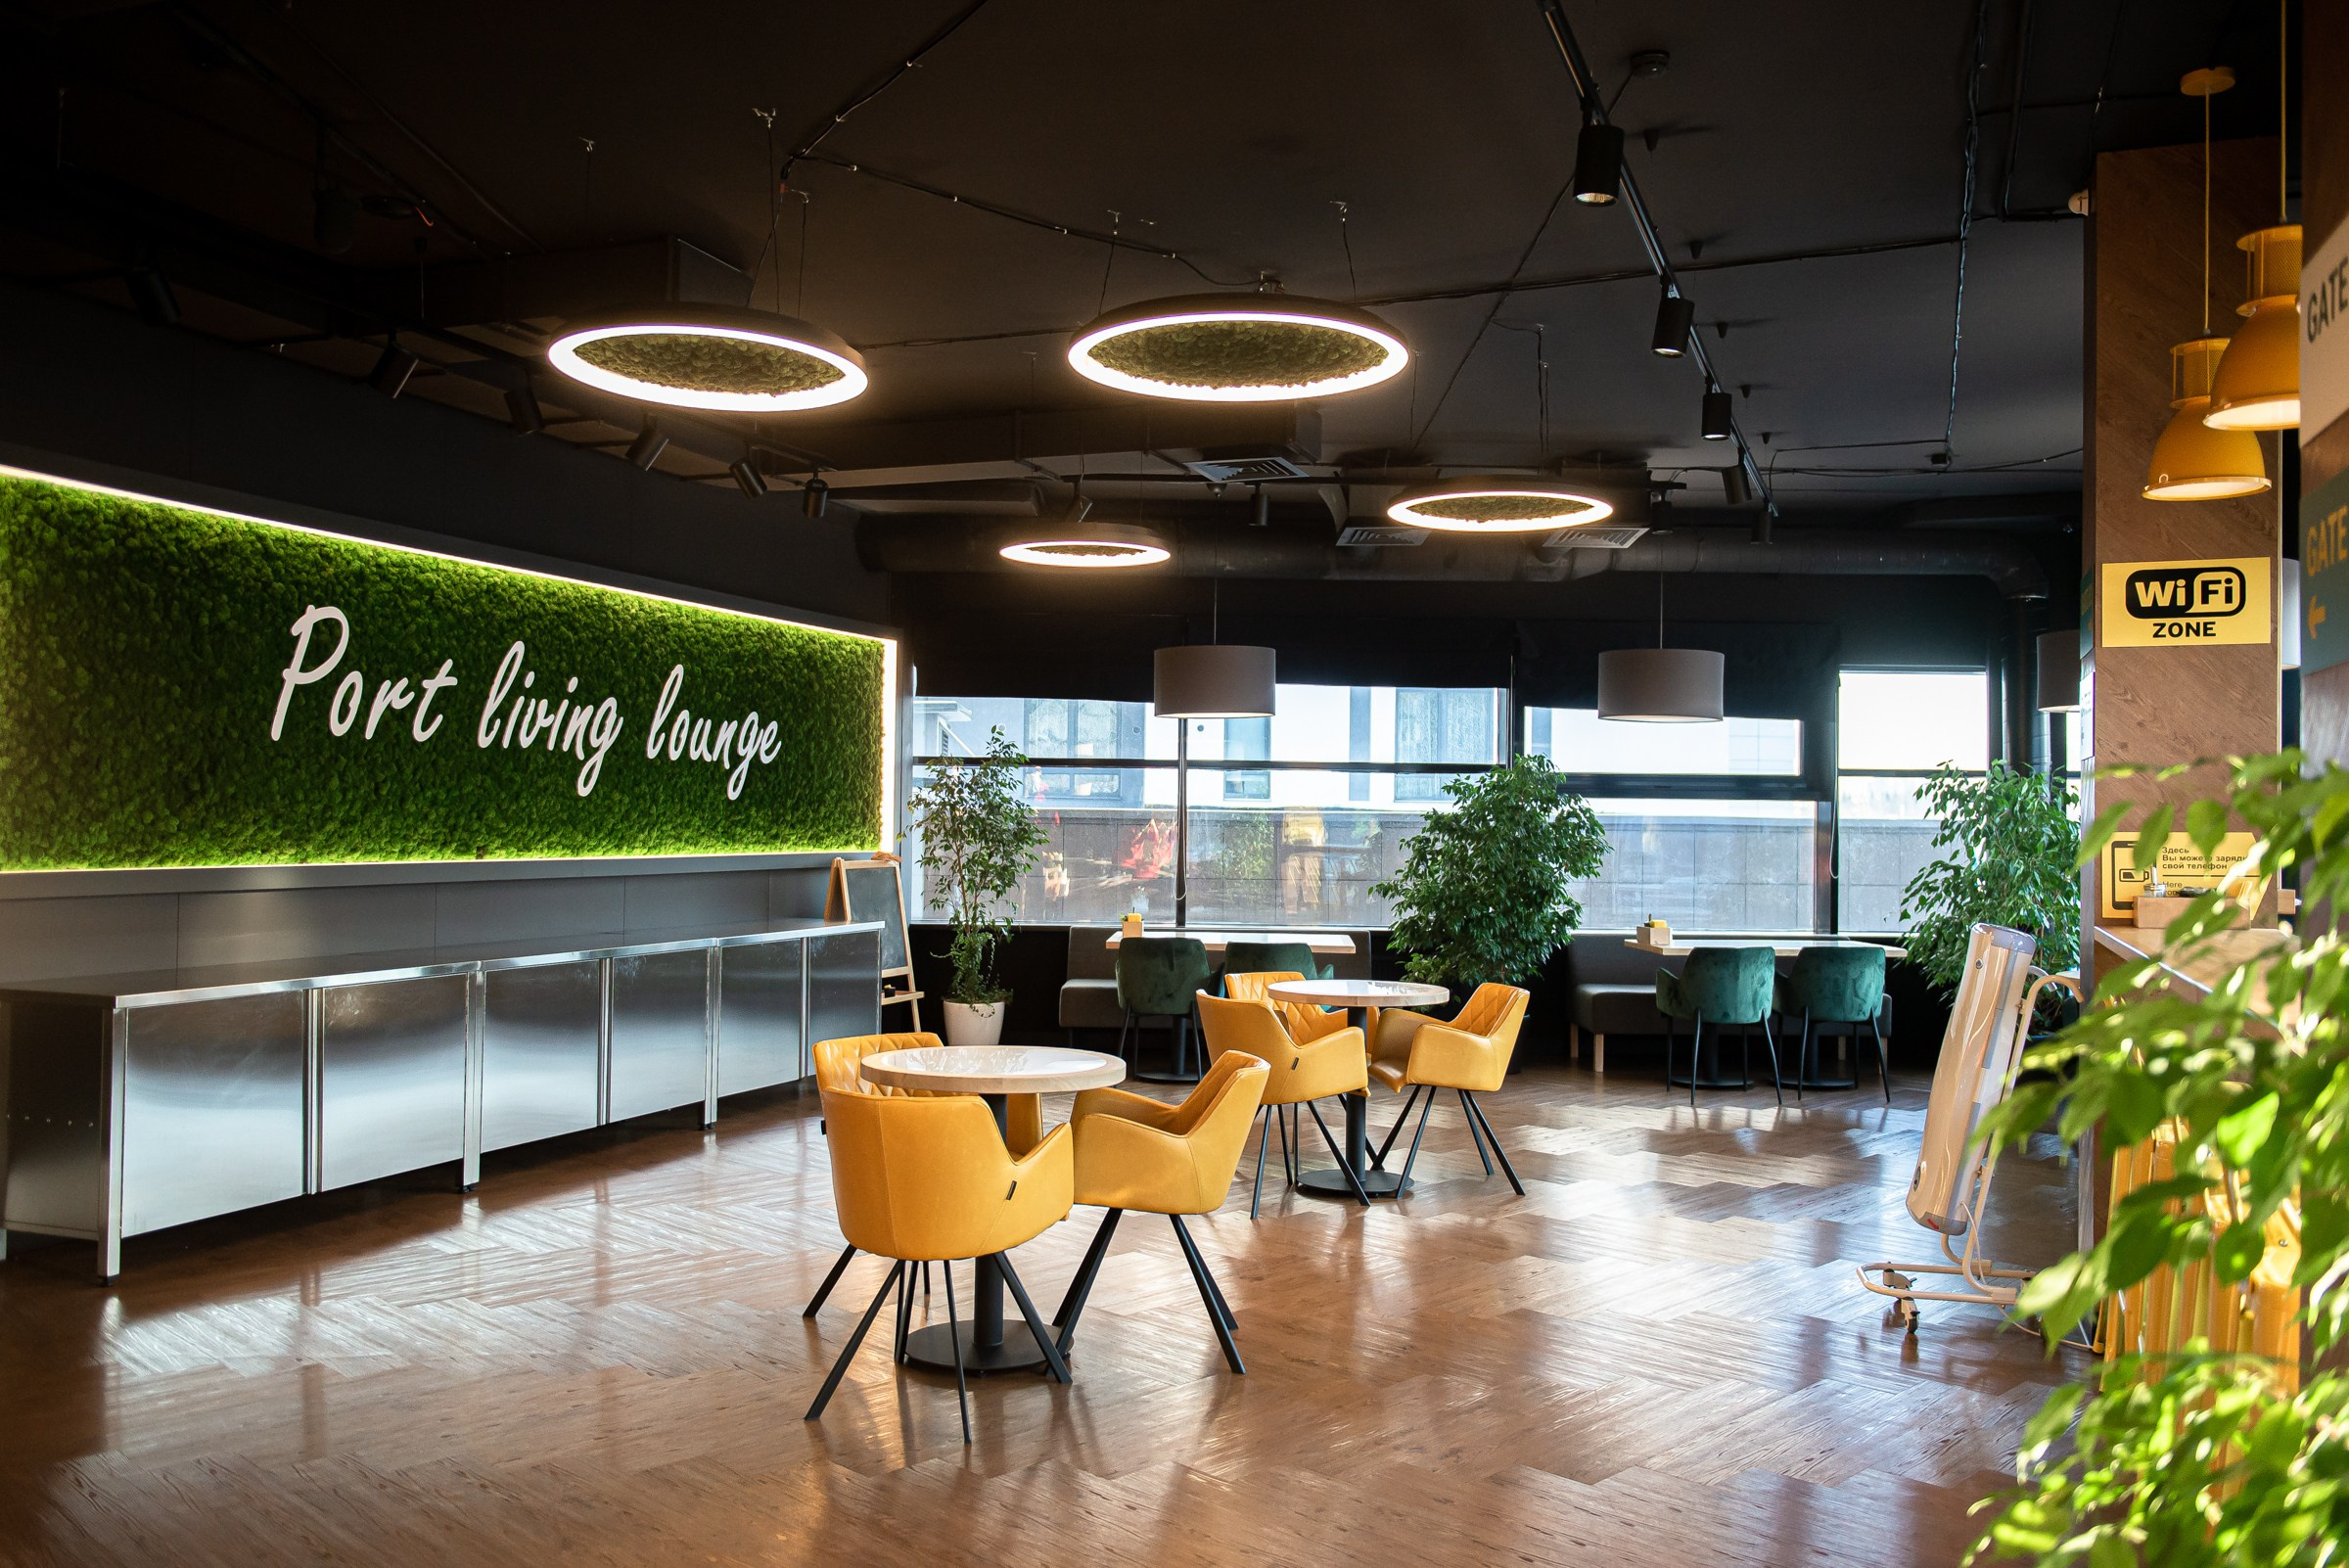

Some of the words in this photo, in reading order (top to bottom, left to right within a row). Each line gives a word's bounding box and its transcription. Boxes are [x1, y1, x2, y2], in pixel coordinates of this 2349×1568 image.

[2307, 255, 2348, 343] GATE
[2307, 504, 2348, 576] GATE
[2152, 621, 2217, 638] ZONE
[270, 604, 458, 742] Port
[477, 640, 623, 797] living
[646, 664, 782, 801] lounge
